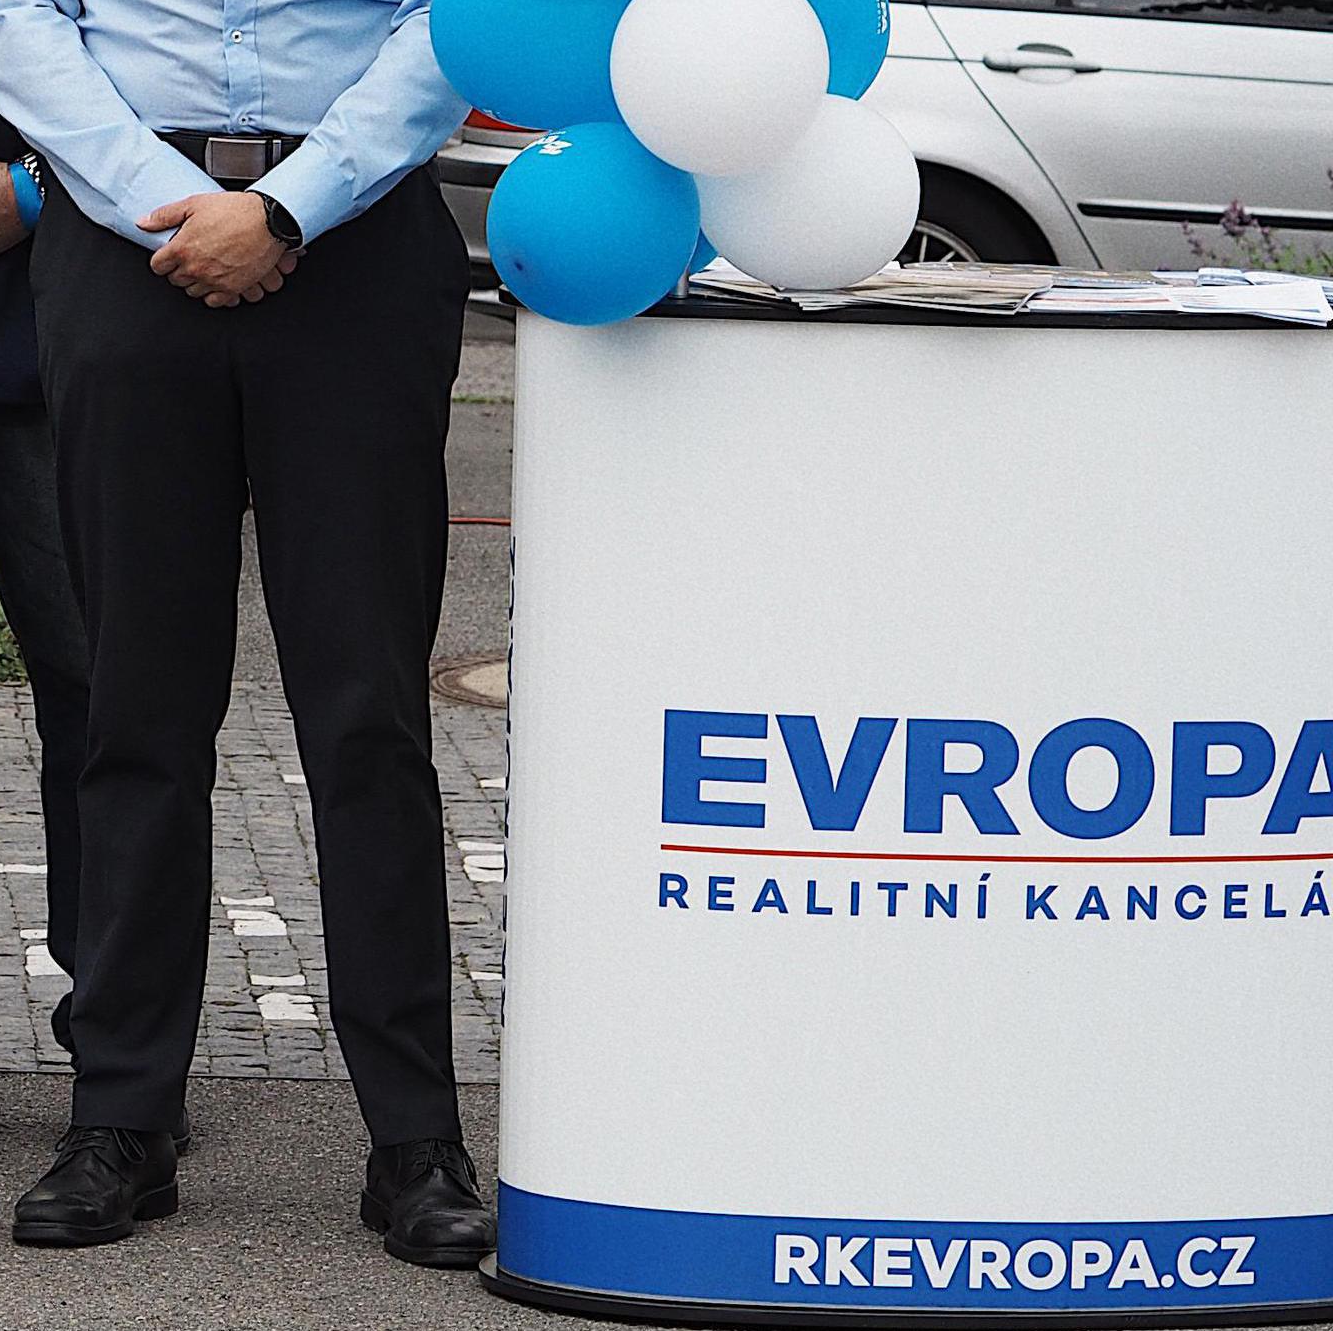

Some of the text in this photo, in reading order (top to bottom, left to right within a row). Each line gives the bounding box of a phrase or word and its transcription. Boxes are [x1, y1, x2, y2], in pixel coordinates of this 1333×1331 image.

[662, 709, 1333, 840] EVROPA
[659, 872, 1333, 921] REALITNÍ KANCELÁ
[774, 1234, 1256, 1291] RKEVROPA.CZ
